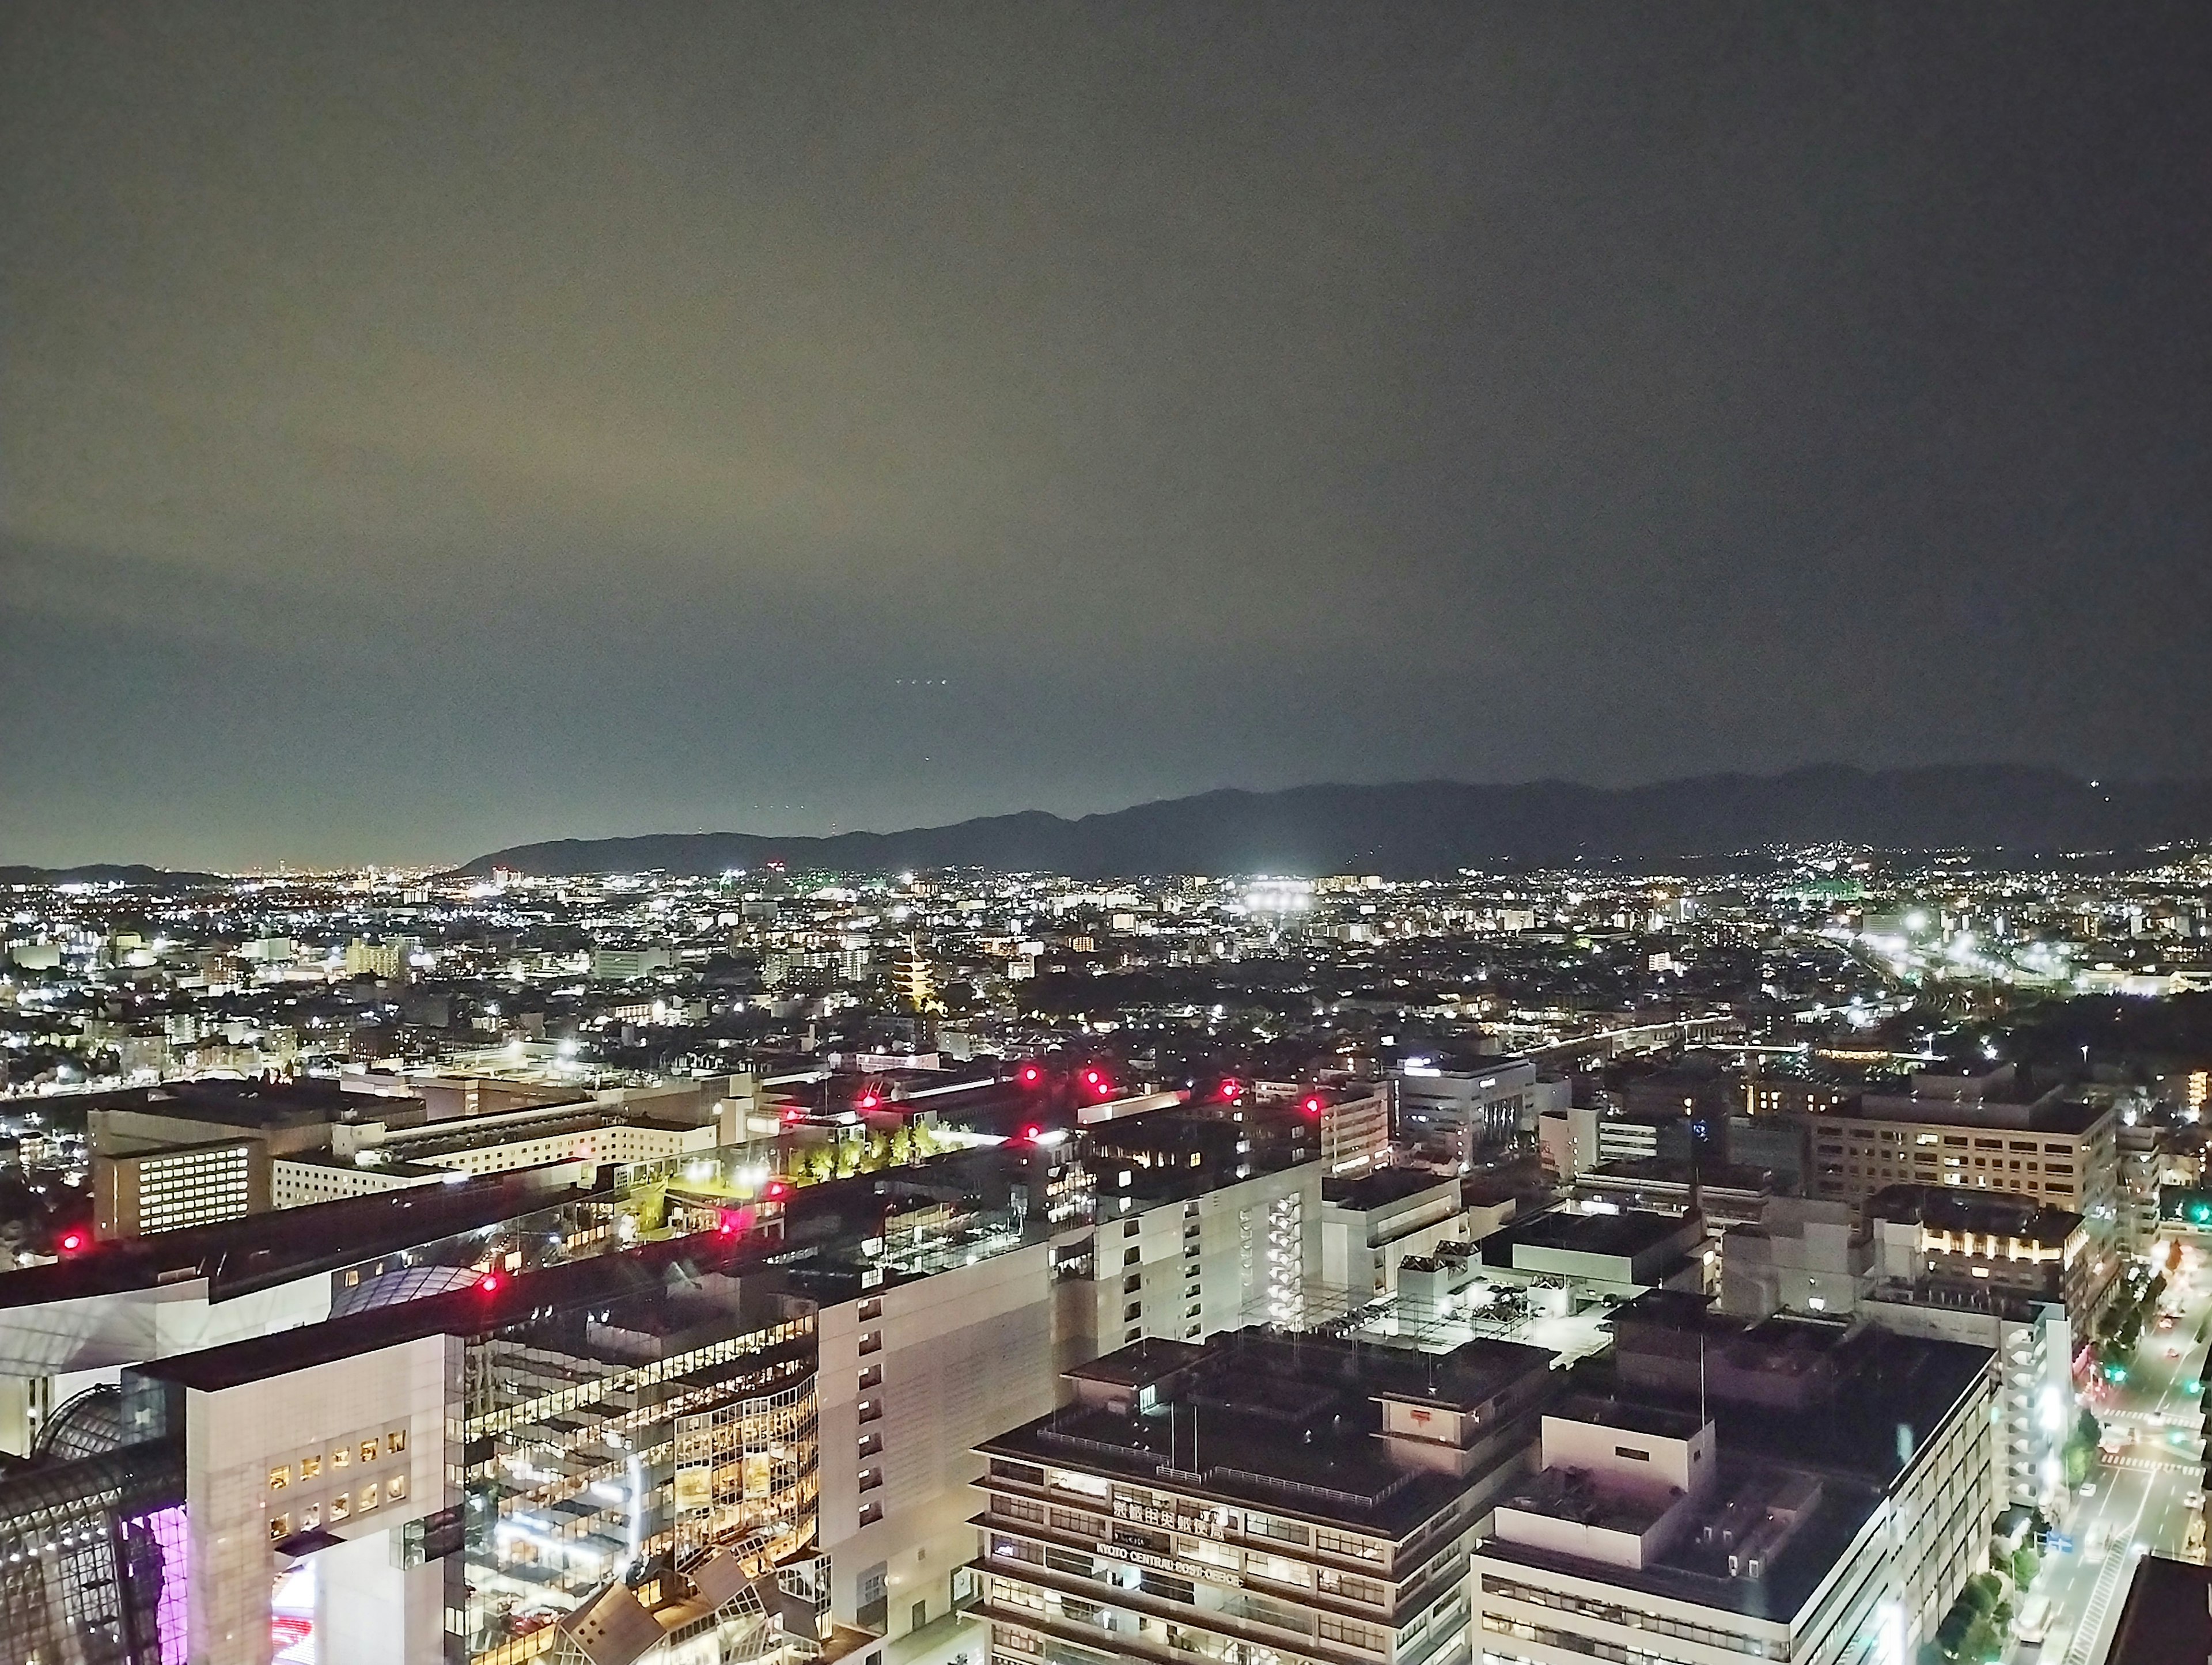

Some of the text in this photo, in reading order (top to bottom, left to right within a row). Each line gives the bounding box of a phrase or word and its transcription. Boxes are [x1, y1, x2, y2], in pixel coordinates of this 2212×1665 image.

[1113, 1500, 1225, 1541] 京都中央郵便局
[1096, 1542, 1240, 1588] KYOTO CENTRAL POST OFFICE
